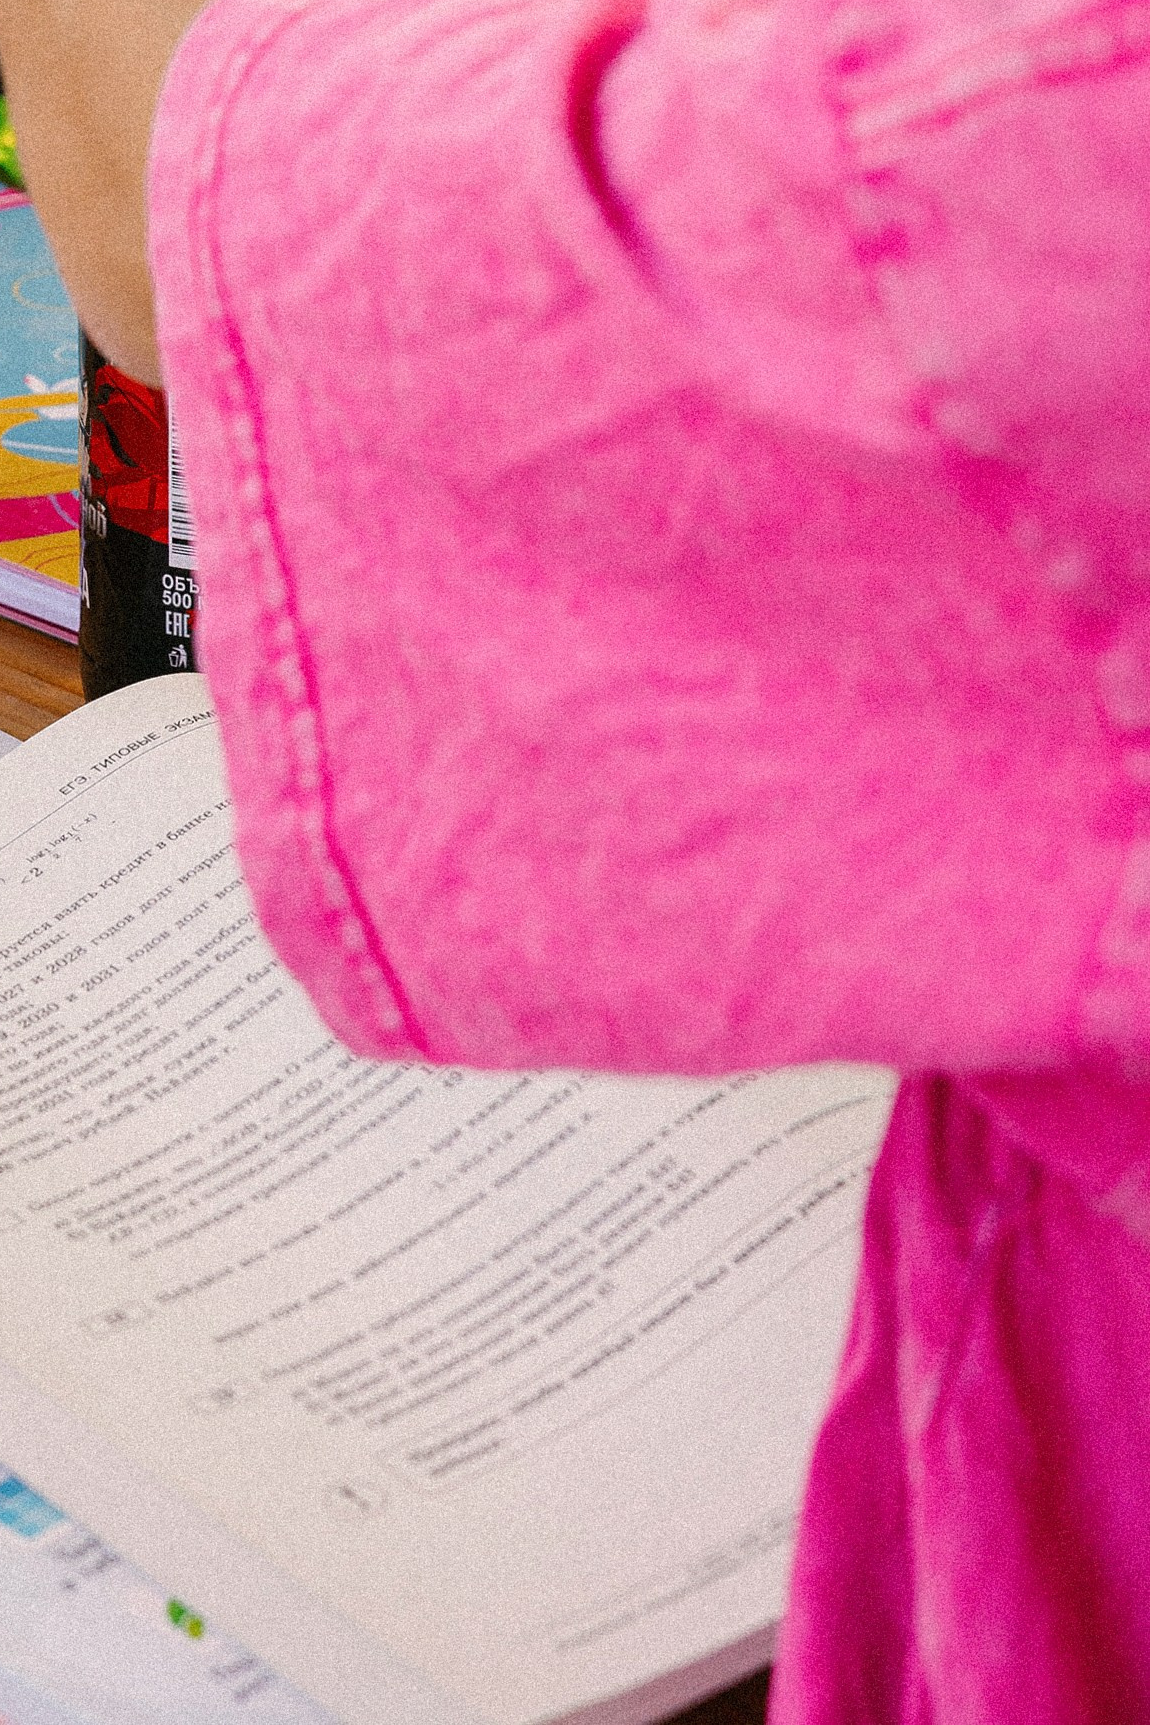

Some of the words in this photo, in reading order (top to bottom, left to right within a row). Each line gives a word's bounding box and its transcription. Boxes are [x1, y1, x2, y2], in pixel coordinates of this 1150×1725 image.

[162, 590, 192, 610] 500
[91, 732, 157, 772] ТИПОВЫЕ
[99, 849, 153, 890] кредит
[165, 810, 211, 841] банке
